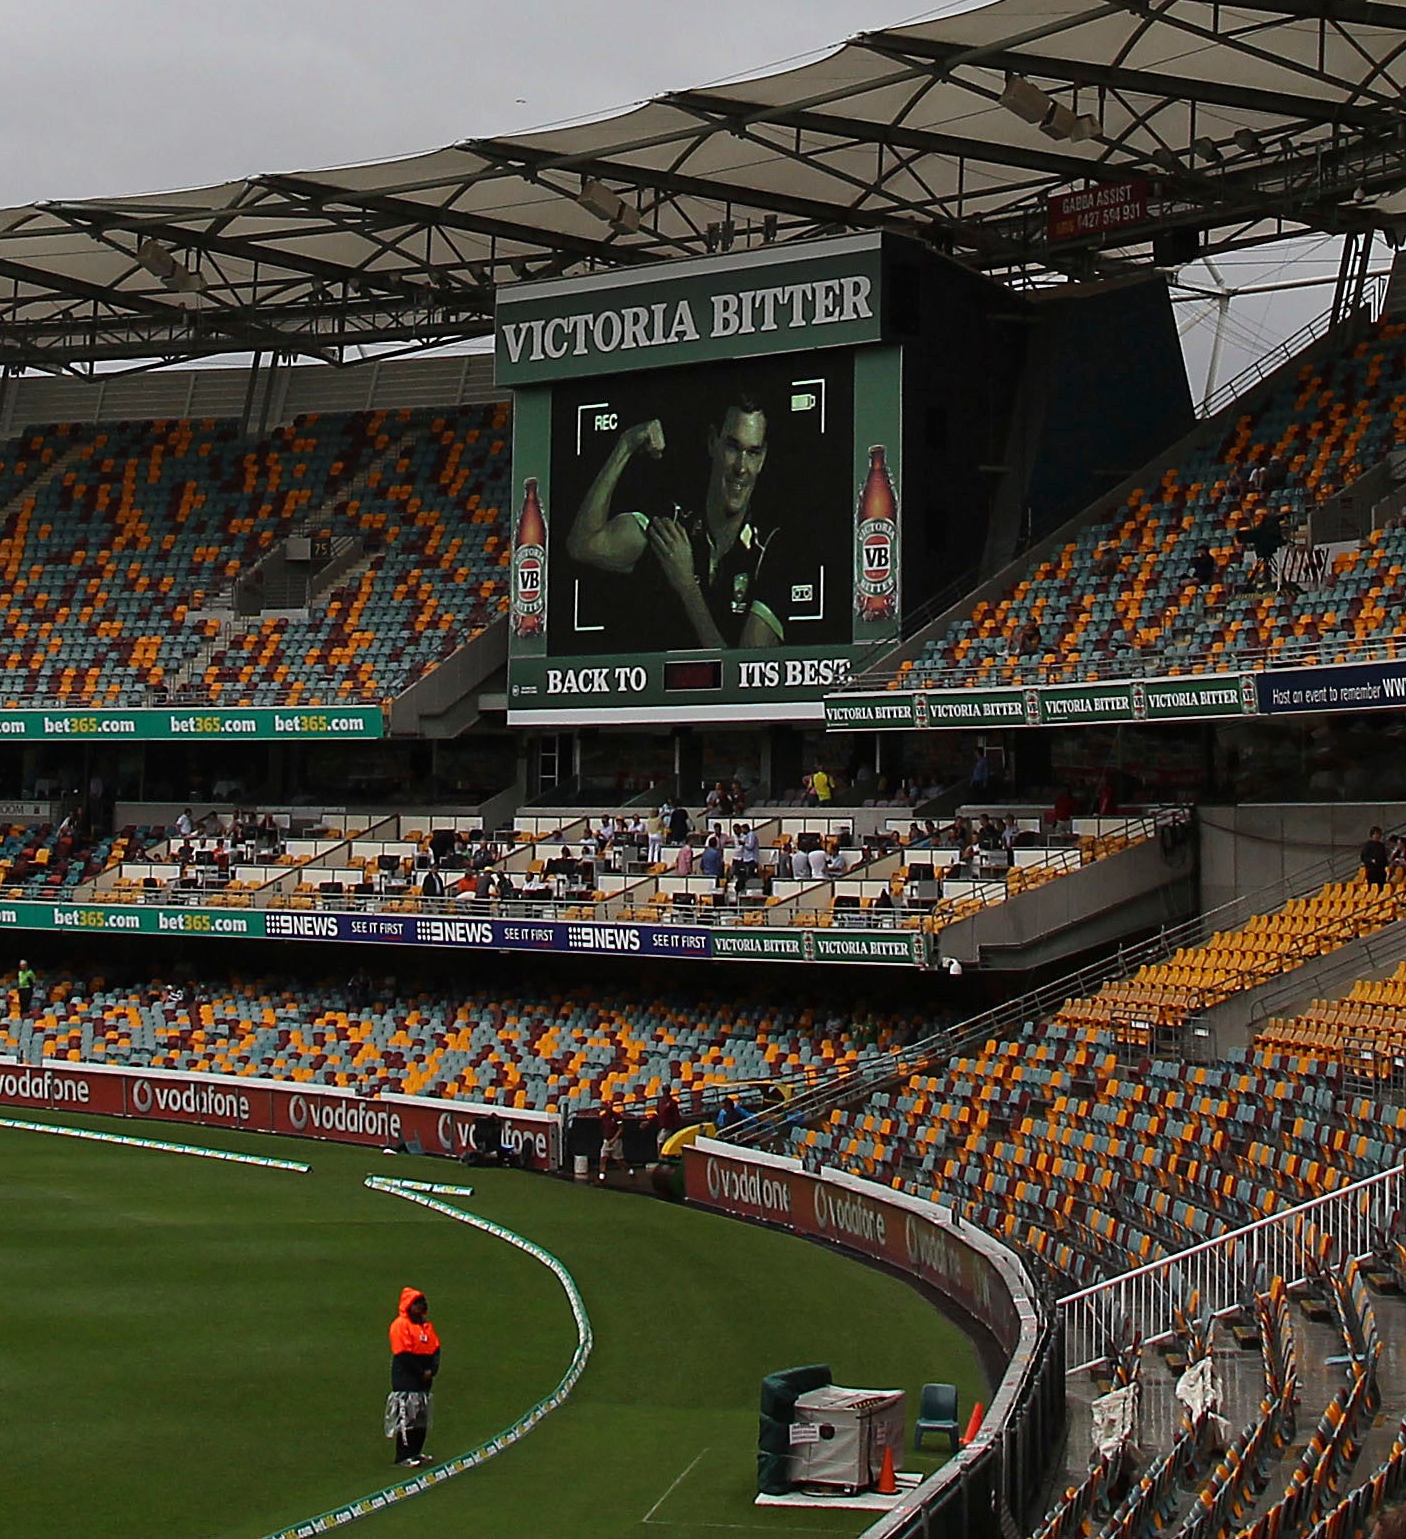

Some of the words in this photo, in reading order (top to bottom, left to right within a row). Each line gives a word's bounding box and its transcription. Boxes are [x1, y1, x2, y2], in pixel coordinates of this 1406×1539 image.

[1062, 193, 1094, 213] GABBA
[1096, 185, 1132, 206] ASSIST
[502, 298, 700, 364] VICTORIA
[710, 275, 873, 338] BITTER
[594, 413, 618, 432] REC
[316, 543, 327, 555] 75
[865, 547, 889, 567] VB
[520, 570, 539, 589] VB
[546, 668, 610, 694] BACK
[614, 667, 647, 691] TO
[738, 661, 779, 688] ITS
[1148, 693, 1199, 709] VICTORIA
[1202, 689, 1238, 705] BITTER
[1273, 688, 1290, 705] Host
[1306, 690, 1328, 703] event
[1330, 687, 1338, 701] to
[1340, 684, 1381, 702] remember
[827, 706, 873, 721] VICTORIA
[875, 705, 911, 719] BITTER
[930, 703, 981, 719] VICTORIA
[984, 701, 1022, 716] BITTER
[1045, 699, 1092, 714] VICTORIA
[1094, 696, 1129, 711] BITTER
[45, 717, 135, 733] bet365.com
[170, 716, 256, 733] bet365.com
[275, 715, 363, 732] bet365.com
[54, 908, 140, 929] bet365.com
[159, 913, 247, 933] bet365.com
[351, 921, 367, 933] SEE
[369, 922, 377, 934] IT
[380, 922, 404, 935] FIRST
[504, 927, 520, 940] SEE
[521, 928, 528, 941] IT
[530, 929, 554, 942] FIRST
[653, 933, 669, 947] SEE
[671, 935, 679, 947] IT
[682, 935, 706, 949] FIRST
[715, 938, 762, 952] VICTORIA
[764, 939, 800, 953] BITTER
[818, 941, 868, 955] VICTORIA
[870, 942, 908, 956] BITTER
[156, 1083, 250, 1120] vodafone
[309, 1099, 401, 1138] vodafone
